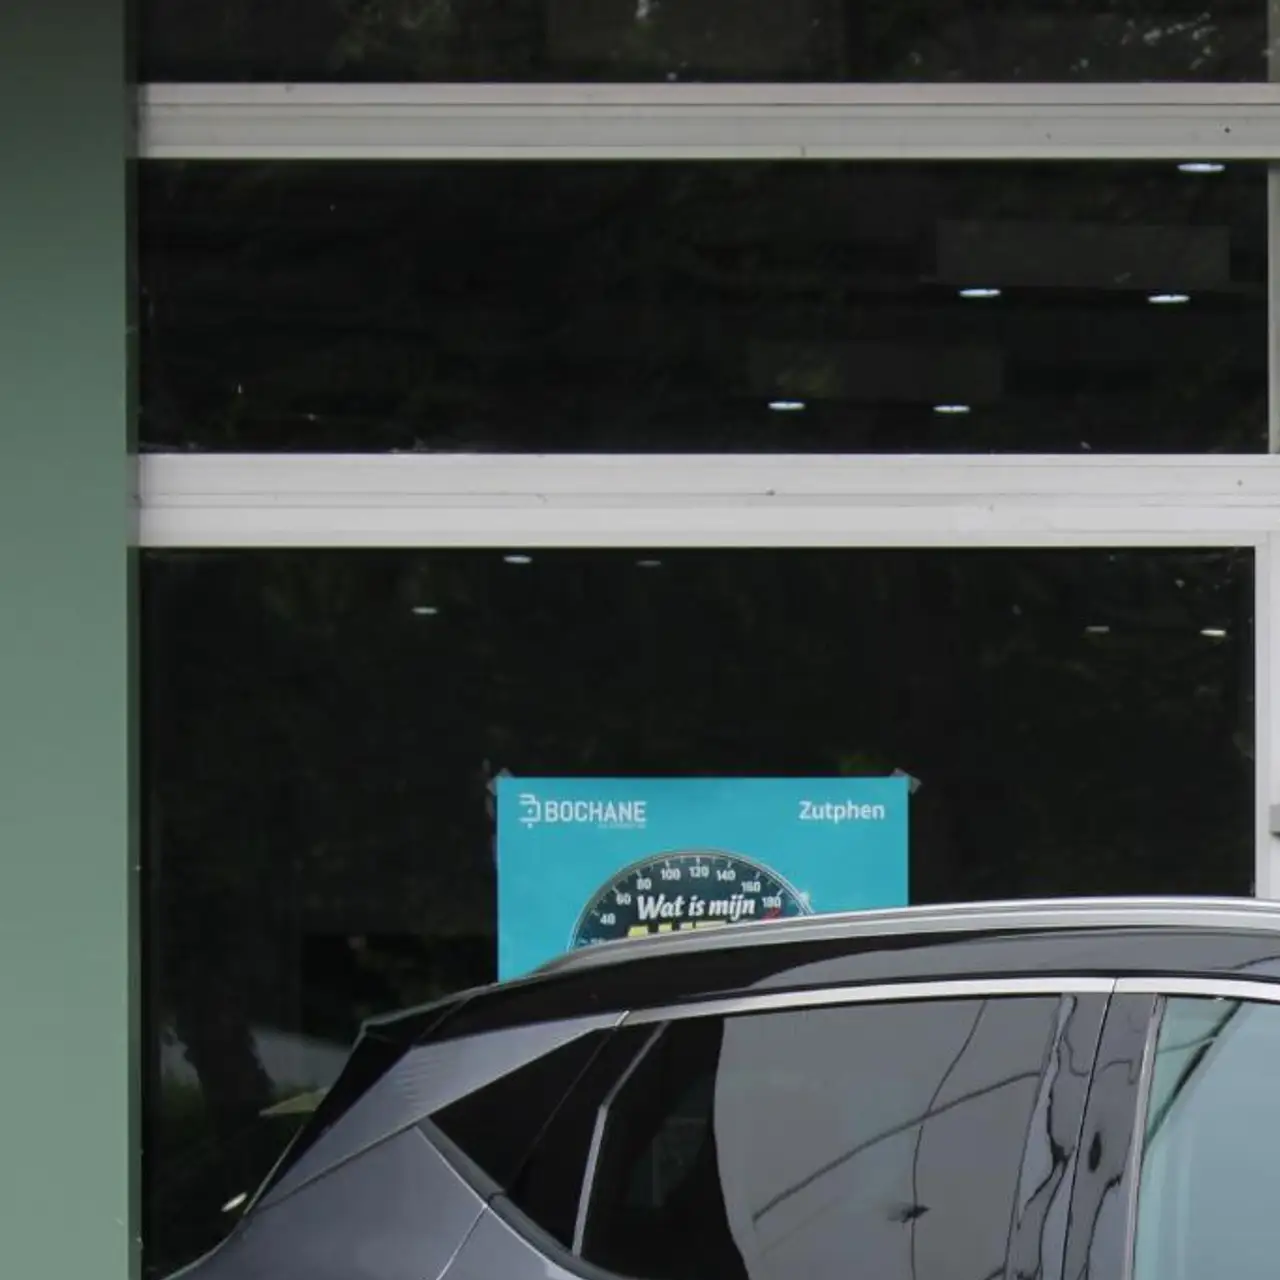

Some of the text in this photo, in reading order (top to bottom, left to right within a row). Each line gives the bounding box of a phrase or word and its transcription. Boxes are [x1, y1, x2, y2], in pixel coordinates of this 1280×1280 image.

[545, 800, 647, 822] BOCHANE
[799, 801, 885, 823] Zutphen
[636, 893, 756, 922] Wat is mijn
[600, 913, 616, 925] 40
